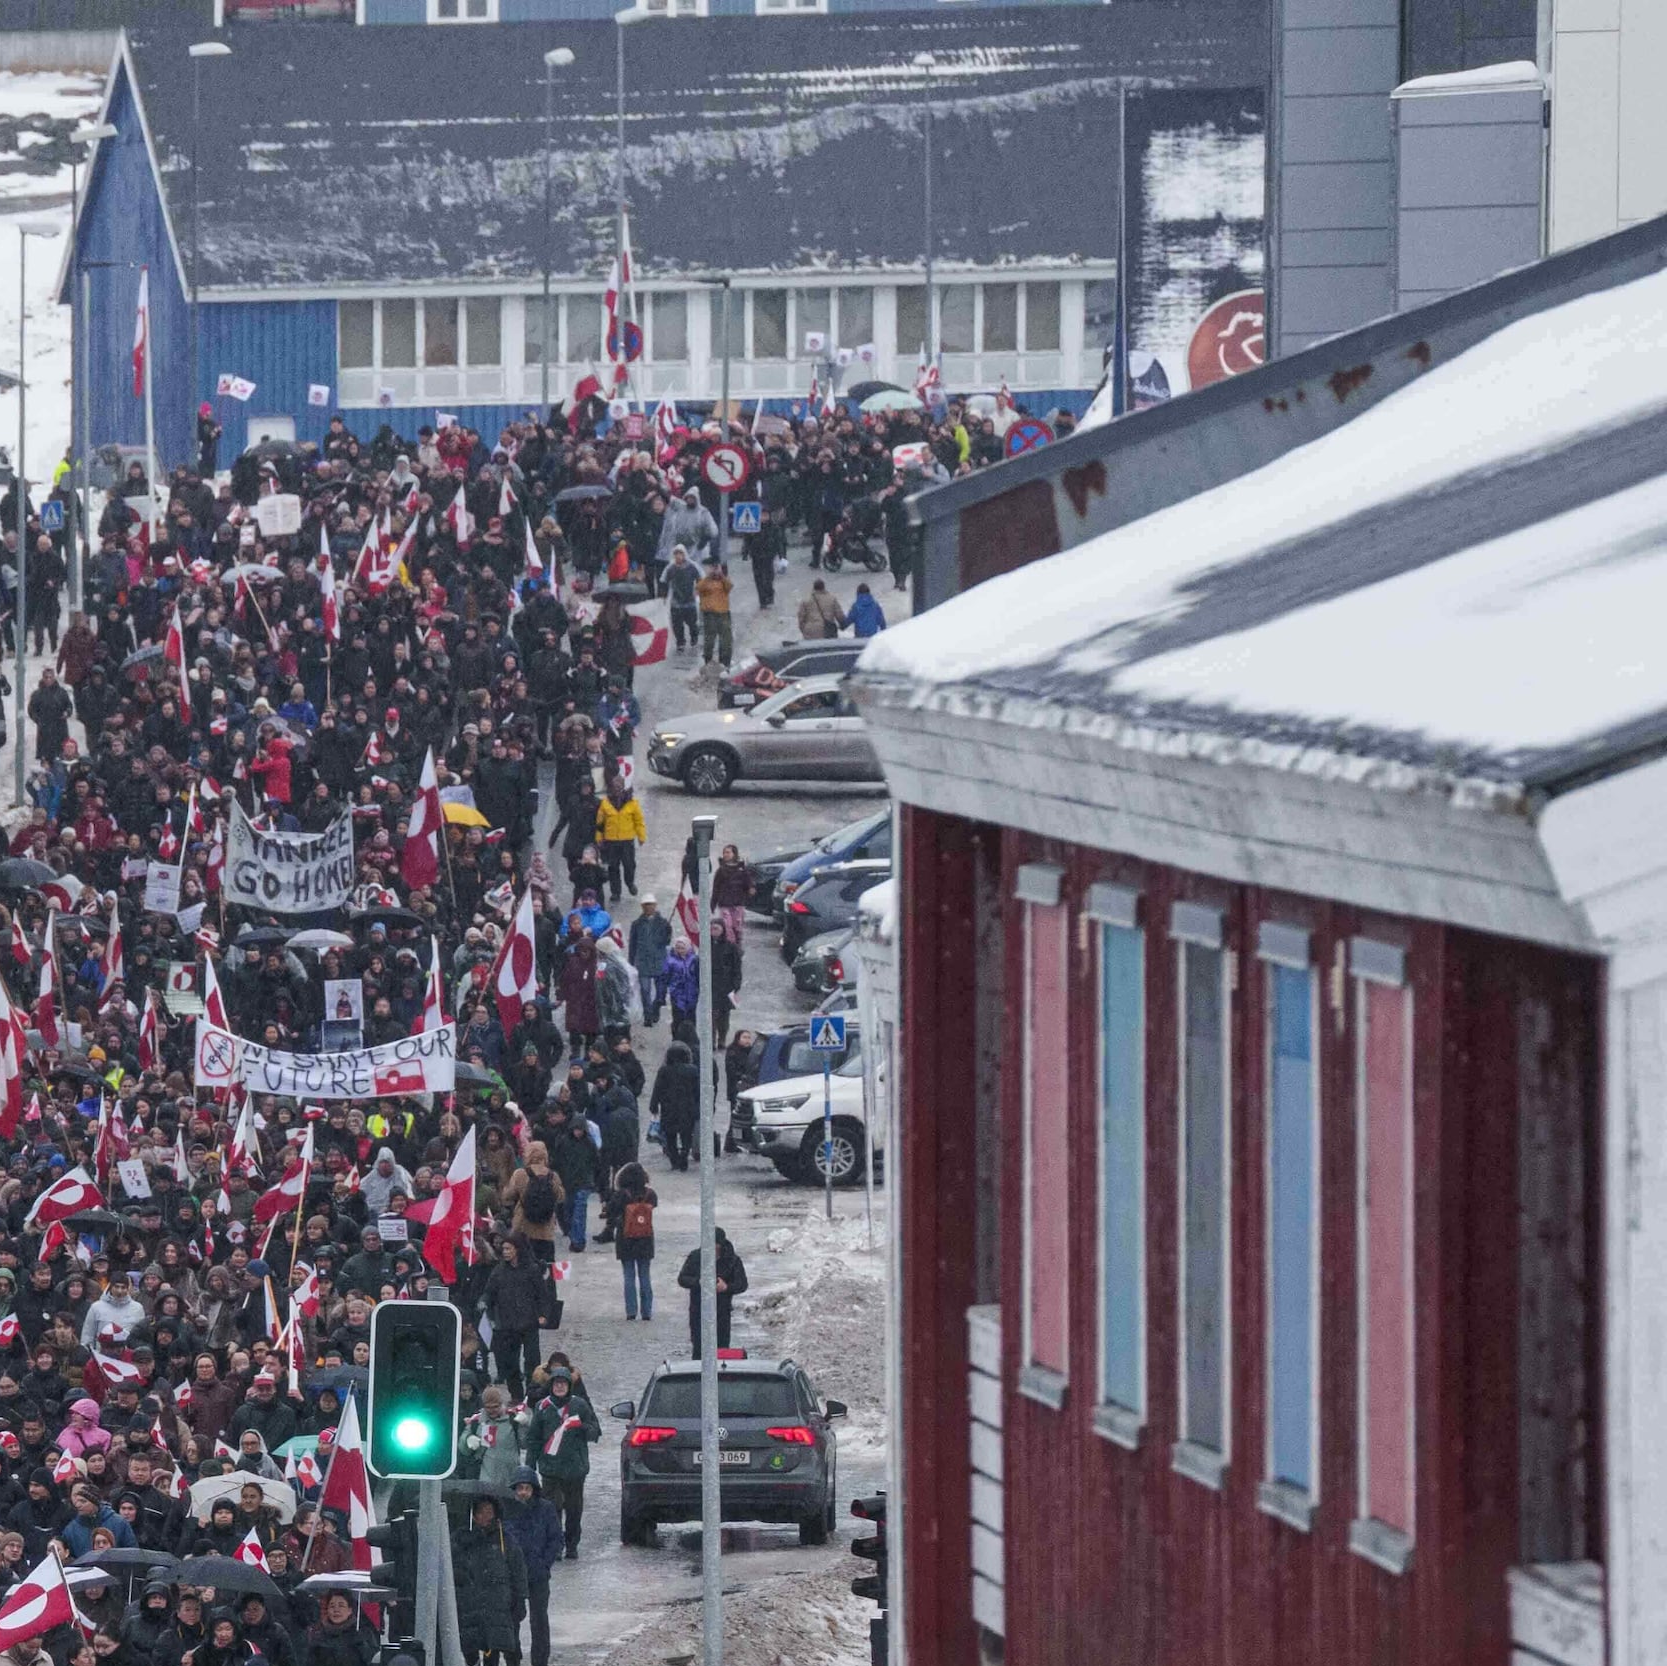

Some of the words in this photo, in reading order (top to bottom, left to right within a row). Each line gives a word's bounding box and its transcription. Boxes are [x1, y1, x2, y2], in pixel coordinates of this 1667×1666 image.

[234, 860, 281, 900] GO
[293, 854, 354, 903] HOME!
[292, 1050, 385, 1070] SHAPE
[395, 1027, 453, 1061] OUR
[727, 1451, 747, 1462] 069
